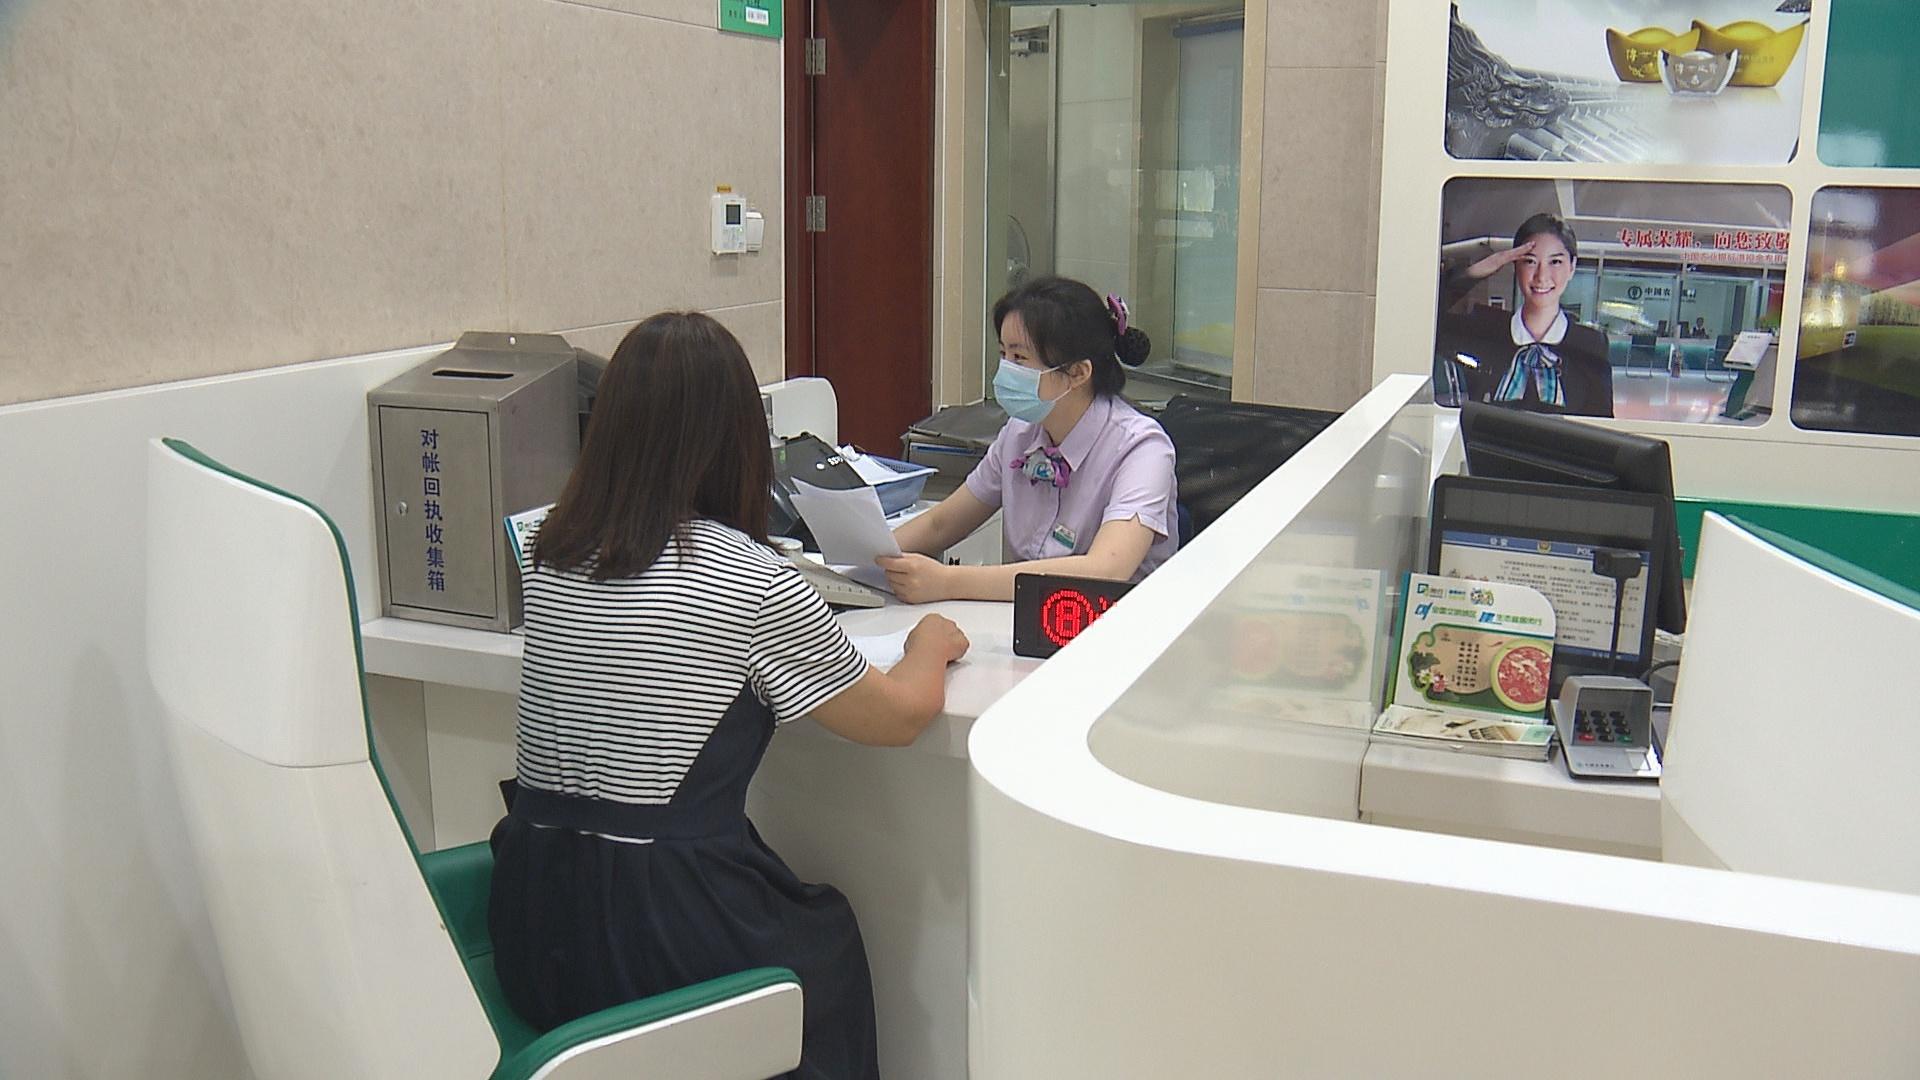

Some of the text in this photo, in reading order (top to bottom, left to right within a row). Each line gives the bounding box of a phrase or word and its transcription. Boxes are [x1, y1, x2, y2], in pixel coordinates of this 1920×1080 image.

[420, 428, 445, 592] 对帐回执收集箱
[1576, 546, 1593, 556] POL
